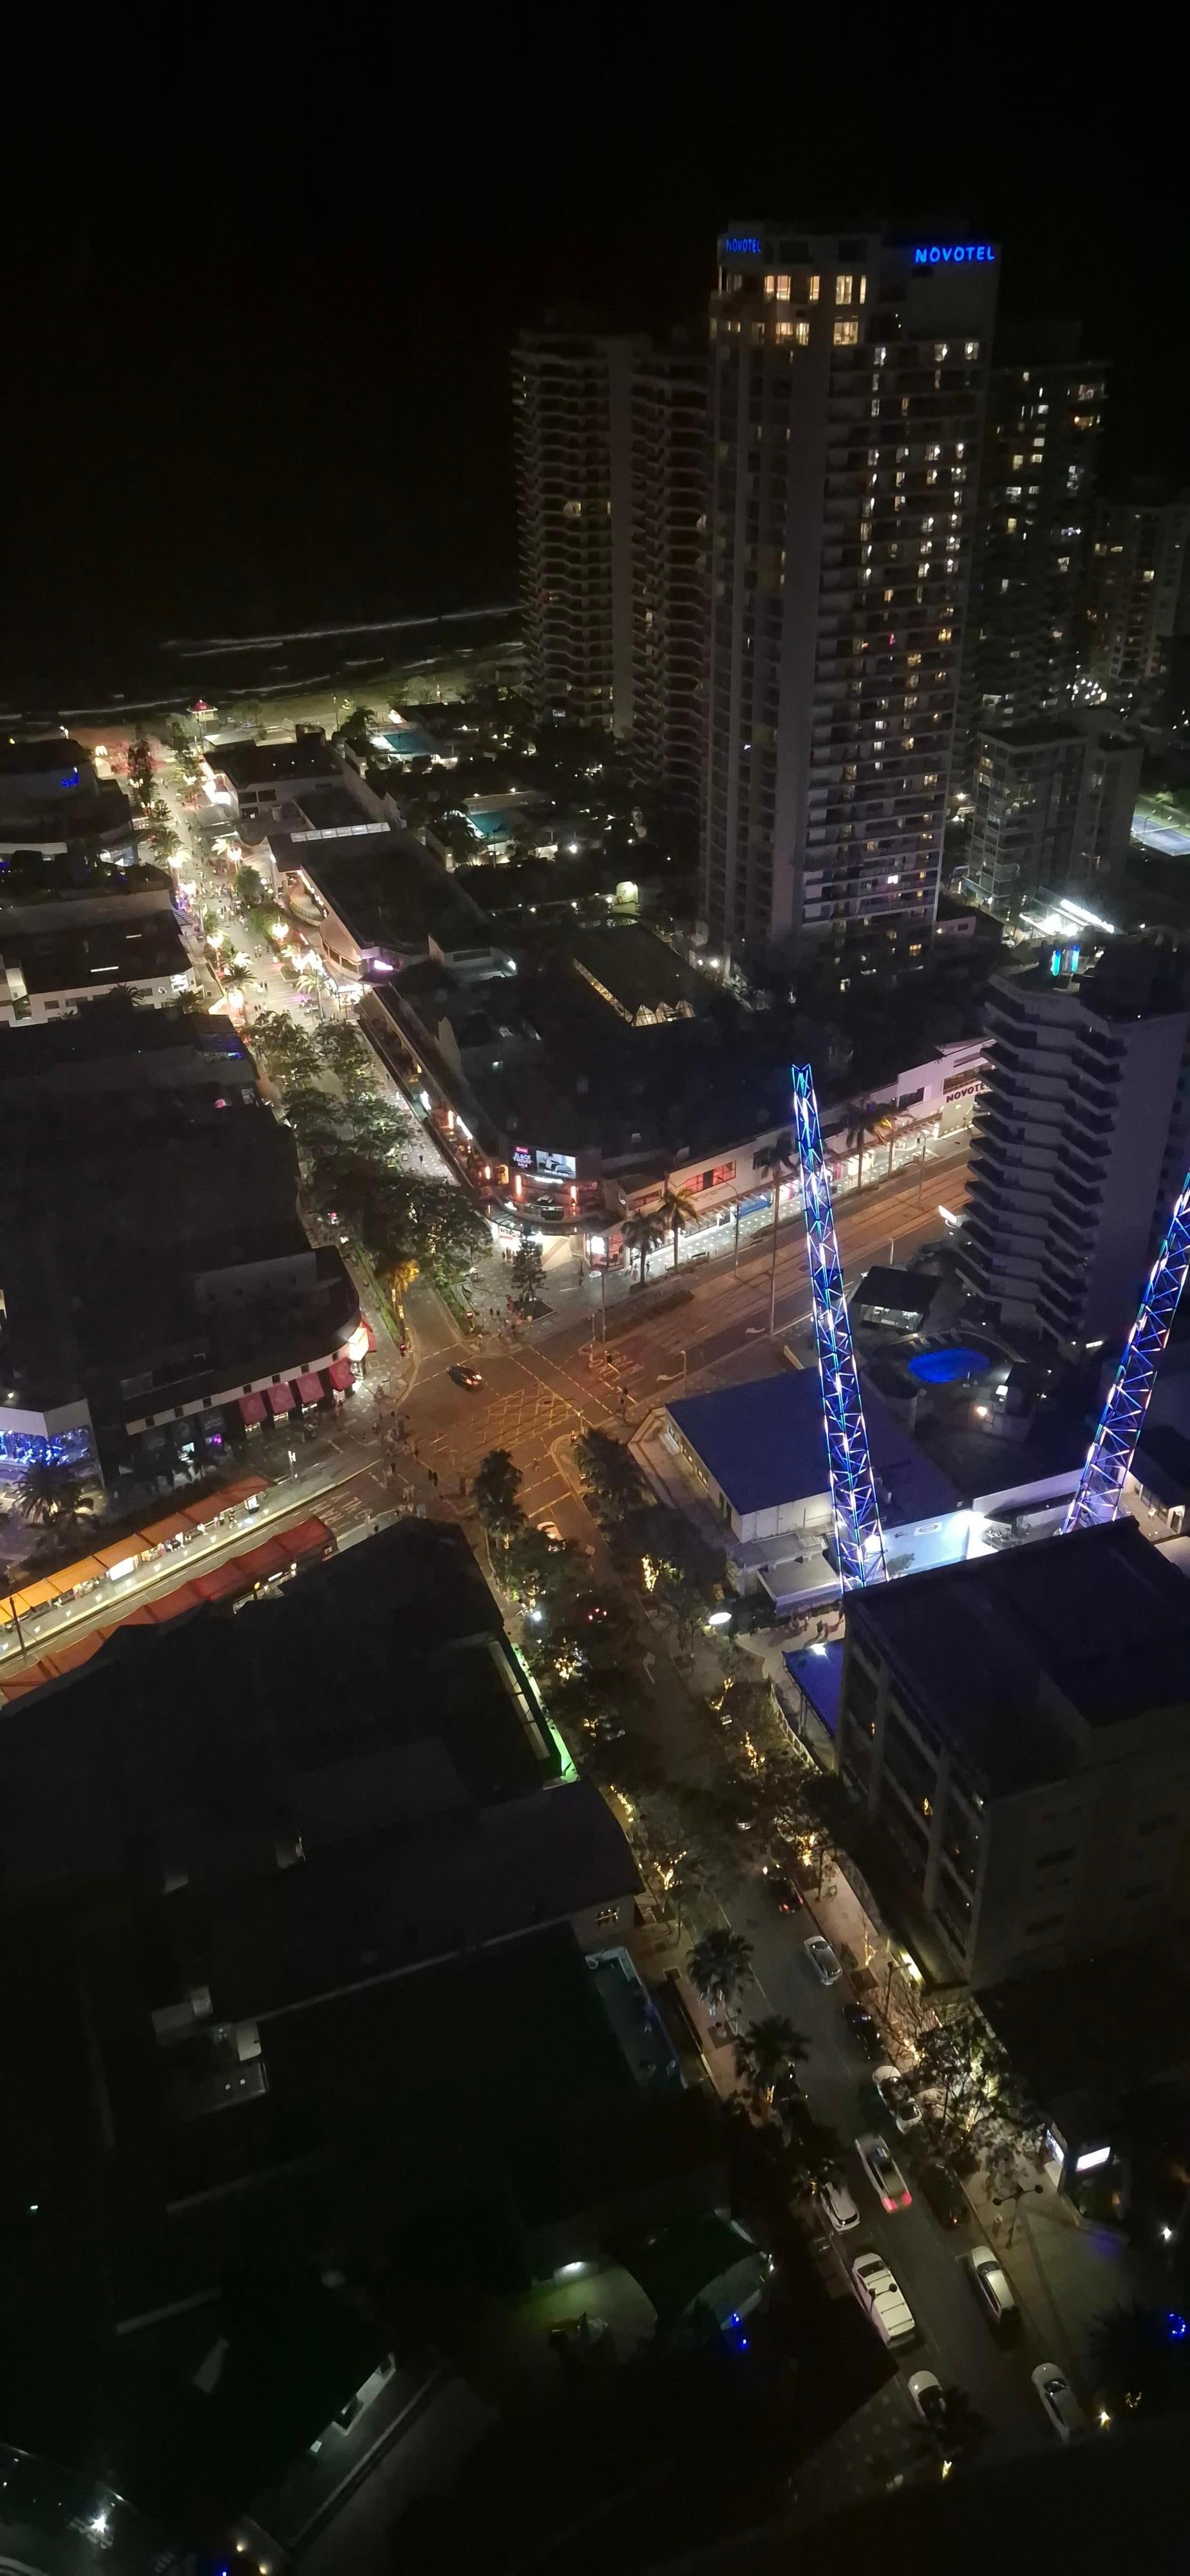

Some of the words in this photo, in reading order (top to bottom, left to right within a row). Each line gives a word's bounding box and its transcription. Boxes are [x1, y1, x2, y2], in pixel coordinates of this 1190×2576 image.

[726, 238, 761, 253] NOVOTEL
[915, 245, 995, 263] NOVOTEL
[946, 1081, 986, 1103] NOVOTE
